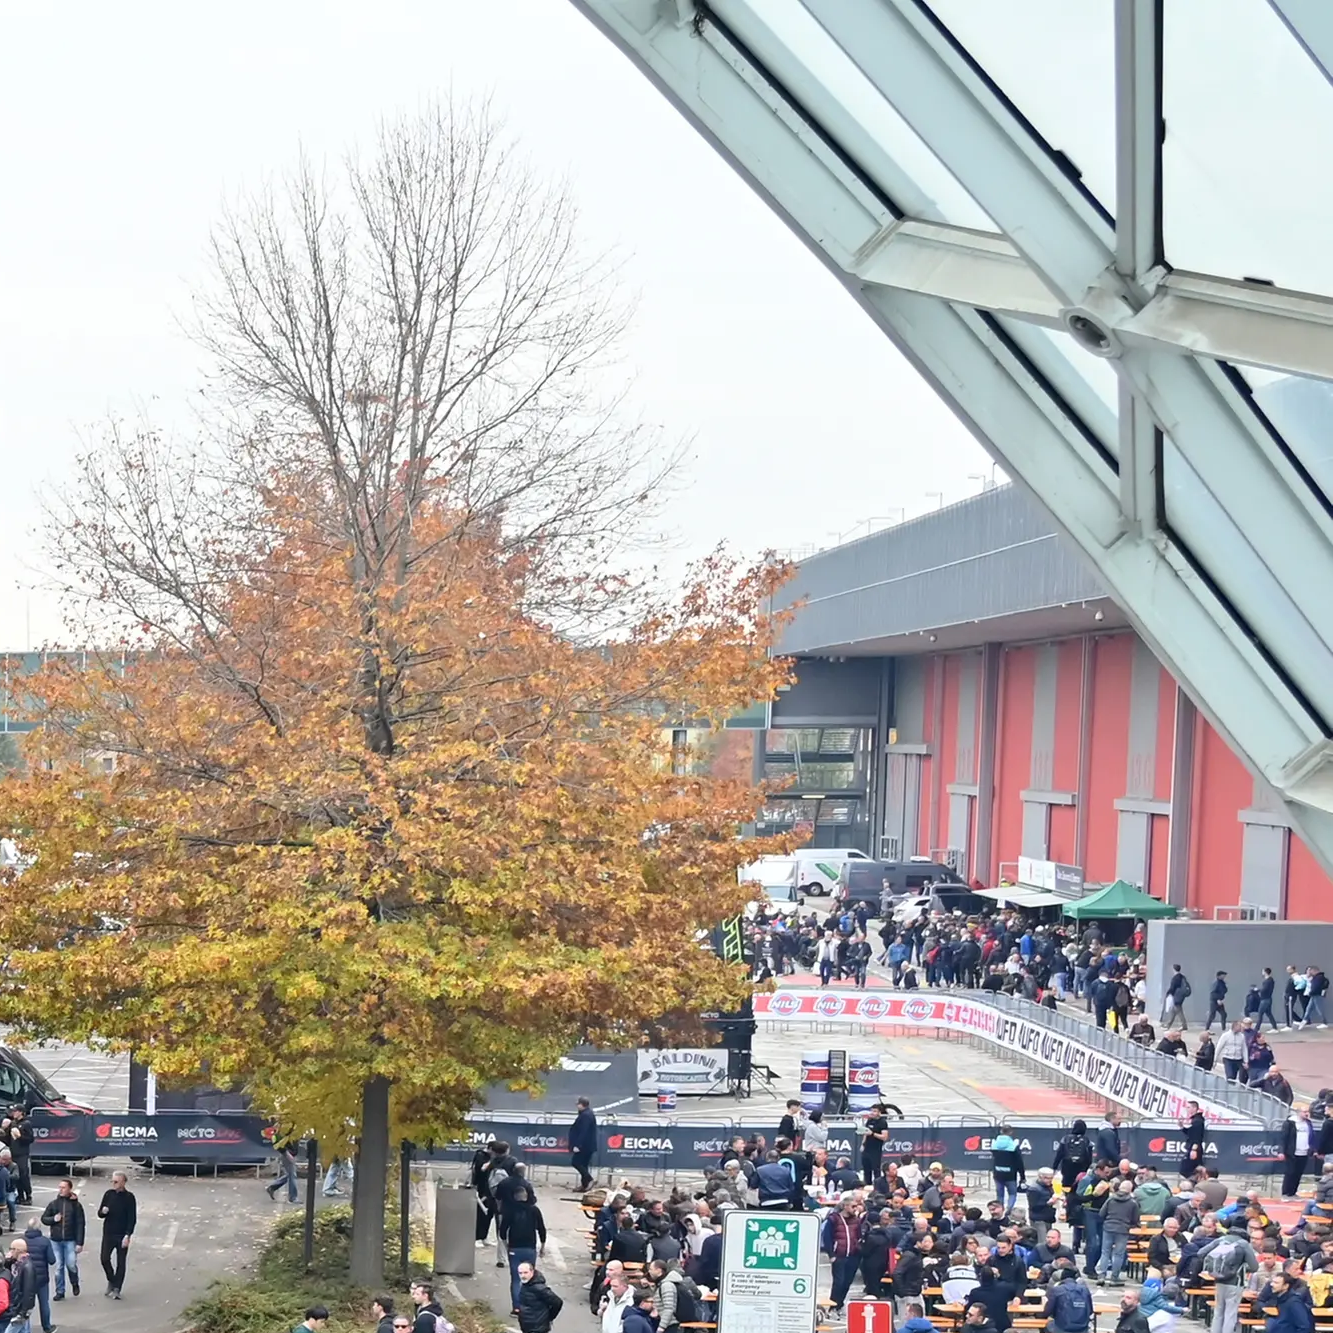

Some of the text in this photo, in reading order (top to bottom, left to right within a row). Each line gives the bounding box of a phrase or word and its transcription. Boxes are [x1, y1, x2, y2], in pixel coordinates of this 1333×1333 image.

[650, 1052, 718, 1070] BALDINI
[112, 1126, 158, 1138] EICMA
[624, 1137, 674, 1150] EICMA
[794, 1278, 806, 1294] 6
